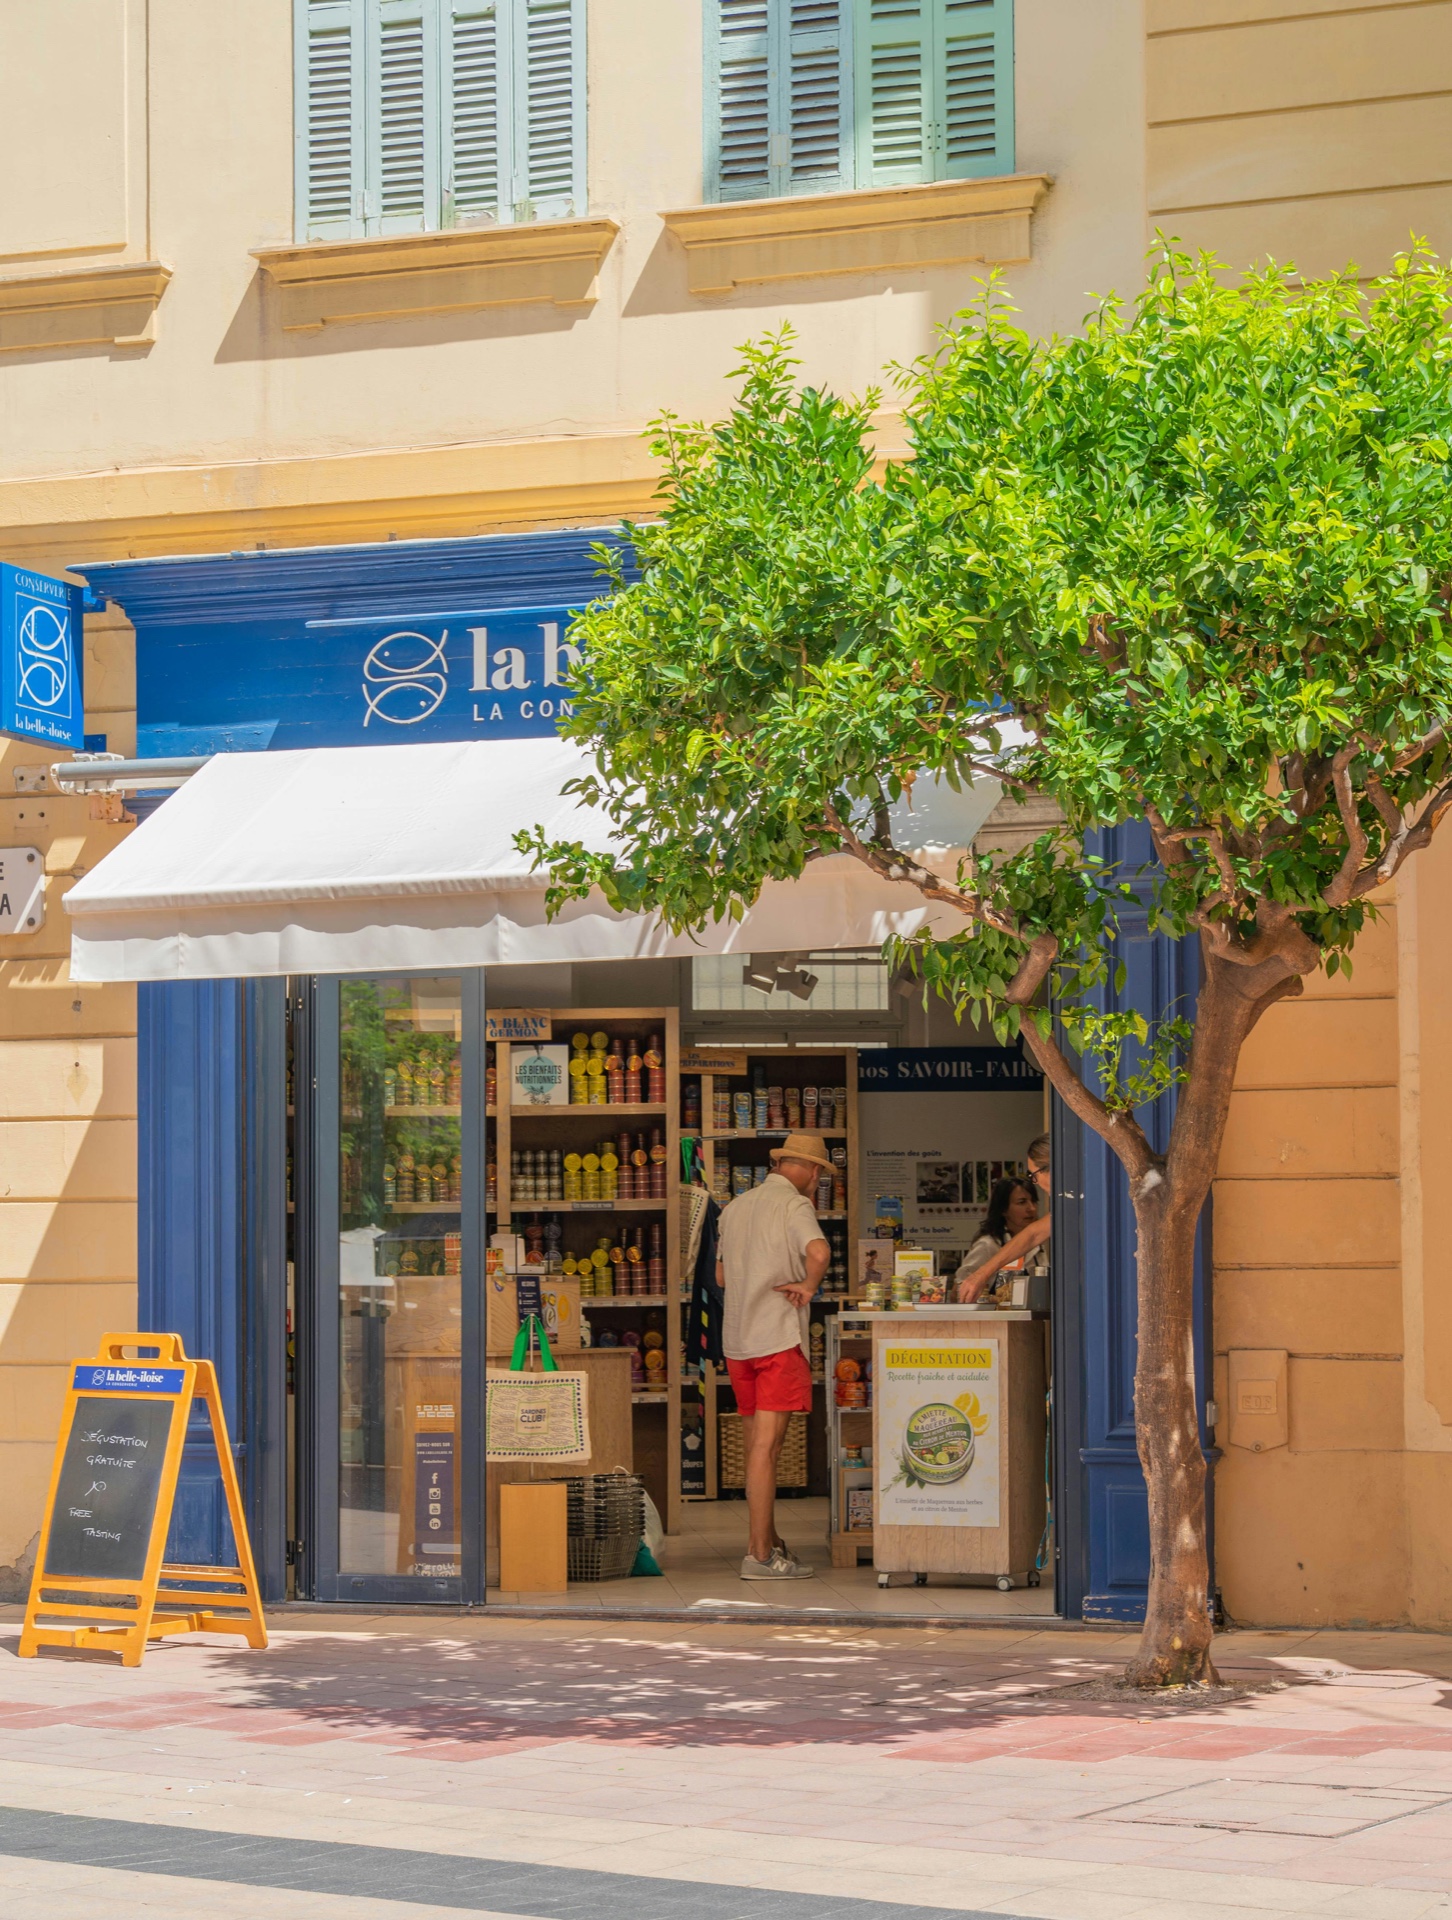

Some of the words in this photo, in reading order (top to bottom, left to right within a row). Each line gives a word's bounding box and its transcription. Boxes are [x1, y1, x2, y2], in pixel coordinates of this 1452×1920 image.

[15, 572, 72, 601] CONSERVERIE
[466, 627, 531, 691] la
[473, 703, 503, 721] LA
[520, 699, 575, 719] CON
[15, 713, 24, 729] la
[25, 713, 72, 742] belle-iloise
[502, 1017, 547, 1029] BLANC
[490, 1028, 539, 1038] GERMON
[515, 1065, 528, 1075] LES
[529, 1065, 562, 1075] BIENFAITS
[897, 1061, 1043, 1078] SAVOIR-FAIR
[515, 1075, 562, 1084] NUTRITIONNELS
[921, 1150, 942, 1158] goûts
[890, 1350, 987, 1365] DÉGUSTATION
[107, 1369, 115, 1381] la
[116, 1370, 164, 1383] belle-iloise
[887, 1371, 916, 1382] Recette
[947, 1372, 955, 1381] et
[957, 1371, 990, 1381] acidulée
[914, 1416, 957, 1431] MAQUEREAU
